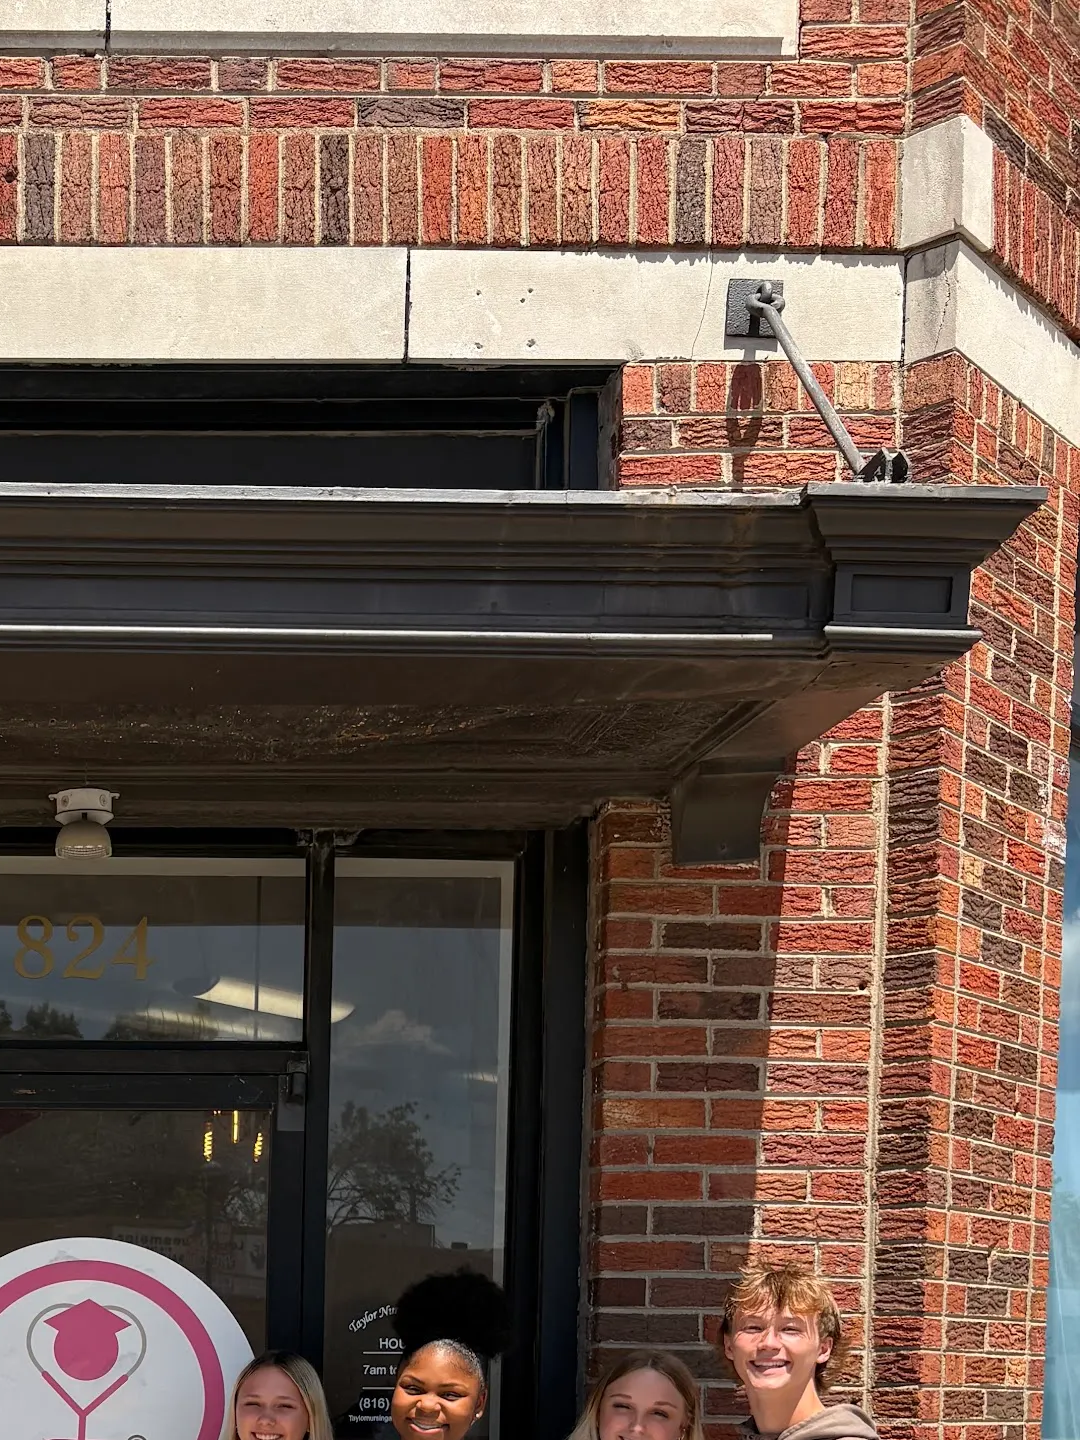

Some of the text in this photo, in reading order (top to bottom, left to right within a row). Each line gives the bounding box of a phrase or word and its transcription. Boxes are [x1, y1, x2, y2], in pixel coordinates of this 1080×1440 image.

[13, 914, 156, 981] 824
[349, 1310, 378, 1333] Taylor
[362, 1364, 387, 1376] 7am
[358, 1397, 390, 1412] (816)
